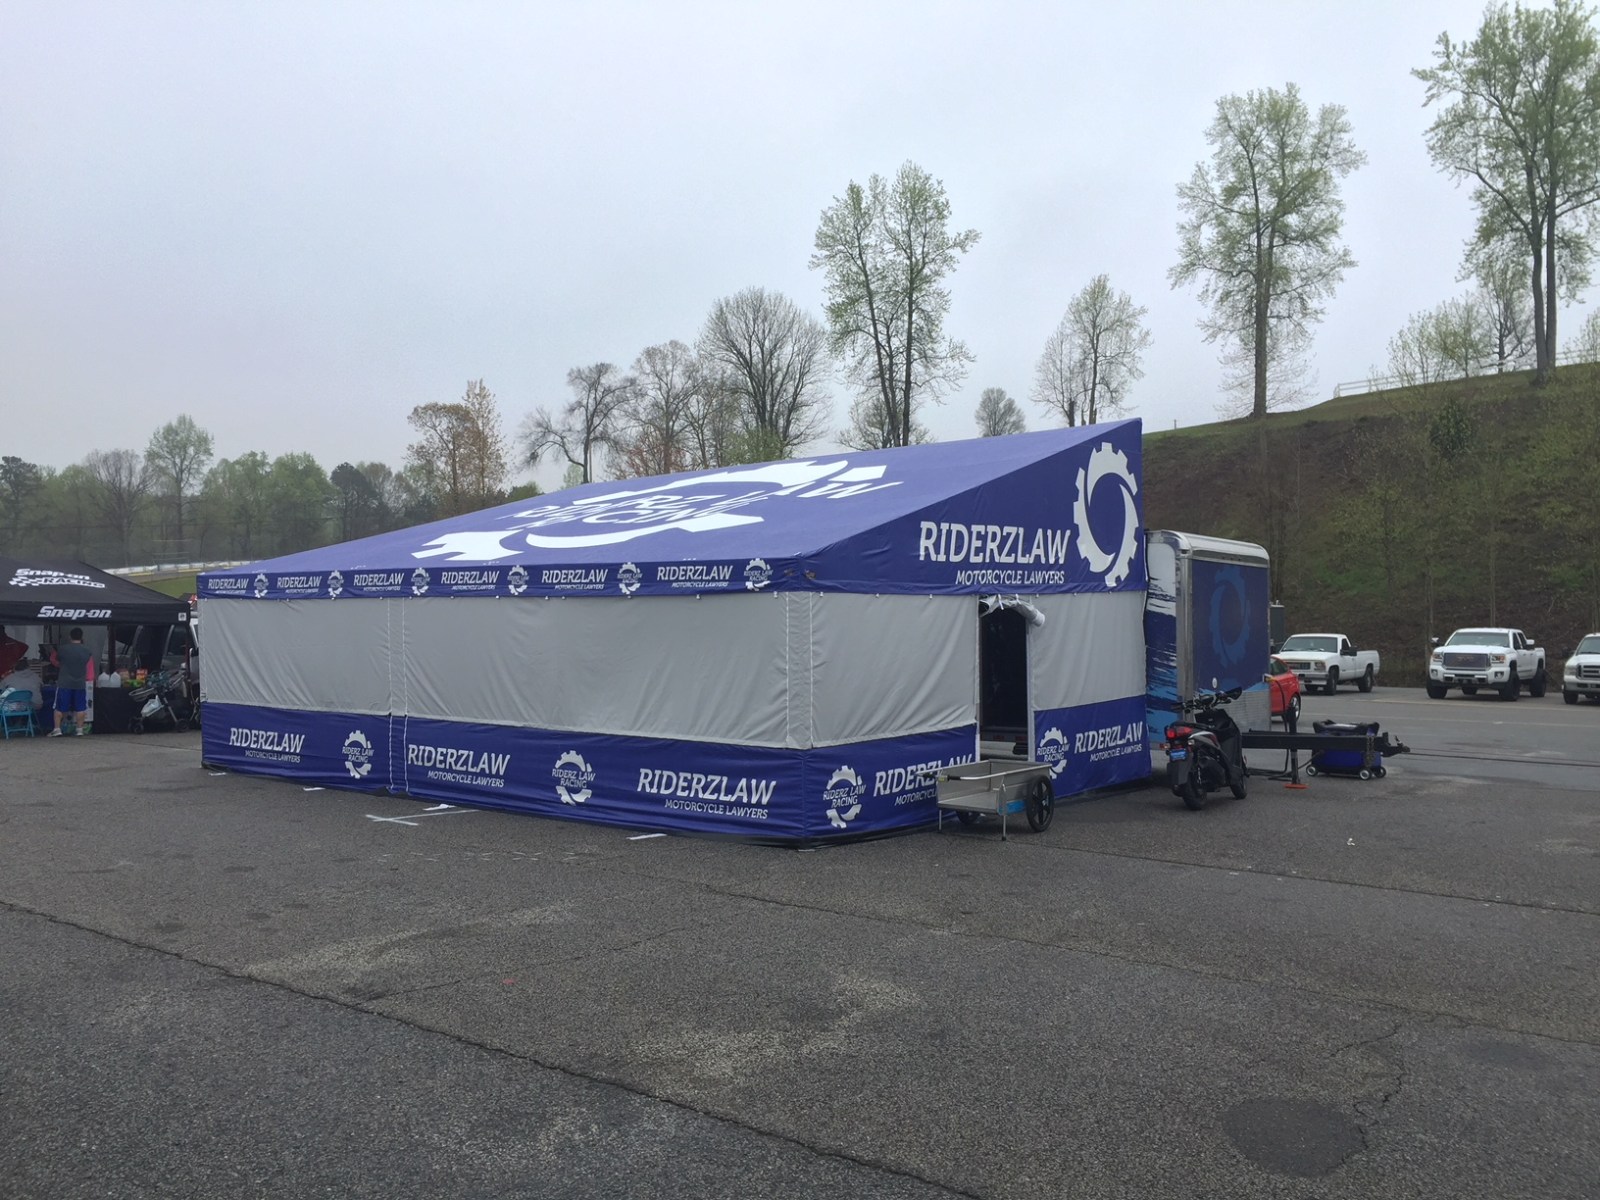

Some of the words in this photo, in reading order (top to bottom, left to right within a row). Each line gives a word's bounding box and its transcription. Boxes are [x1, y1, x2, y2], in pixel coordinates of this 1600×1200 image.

[919, 521, 1071, 564] RIDERZLAW
[15, 568, 90, 580] Snap-on
[354, 573, 404, 586] RIDERZLAW
[441, 571, 500, 584] RIDERZLAW
[542, 569, 608, 583] RIDERZLAW
[657, 566, 733, 580] RIDERZLAW
[955, 569, 1022, 586] MOTORCYCLE
[1024, 570, 1065, 584] LAWYERS
[208, 578, 249, 590] RIDERZLAW
[277, 576, 322, 588] RIDERZLAW
[37, 606, 112, 620] Snap-on
[229, 728, 305, 753] RIDERZLAW
[1074, 720, 1143, 754] RIDERZLAW
[245, 750, 277, 760] MOTORCYCLE
[278, 753, 301, 763] LAWYERS
[342, 746, 361, 755] RIDERZ
[361, 748, 374, 756] LAW
[1037, 746, 1058, 756] RIDERZ
[1058, 743, 1070, 752] LAW
[1090, 747, 1120, 762] MOTORCYCLE
[1121, 744, 1142, 755] LAWYERS
[348, 754, 368, 763] RACING
[408, 744, 510, 776] RIDERZLAW
[1043, 752, 1065, 762] RACING
[427, 770, 472, 784] MOTORCYCLE
[472, 775, 504, 787] LAWYERS
[552, 768, 577, 779] RIDERZ
[578, 770, 596, 782] LAW
[560, 777, 587, 788] RACING
[636, 768, 777, 806] RIDERZLAW
[823, 788, 849, 800] RIDERZ
[850, 784, 866, 796] LAW
[894, 788, 937, 806] MOTORCYCL
[831, 796, 858, 808] RACING
[664, 799, 724, 815] MOTORCYCLE
[725, 806, 769, 820] LAWYERS
